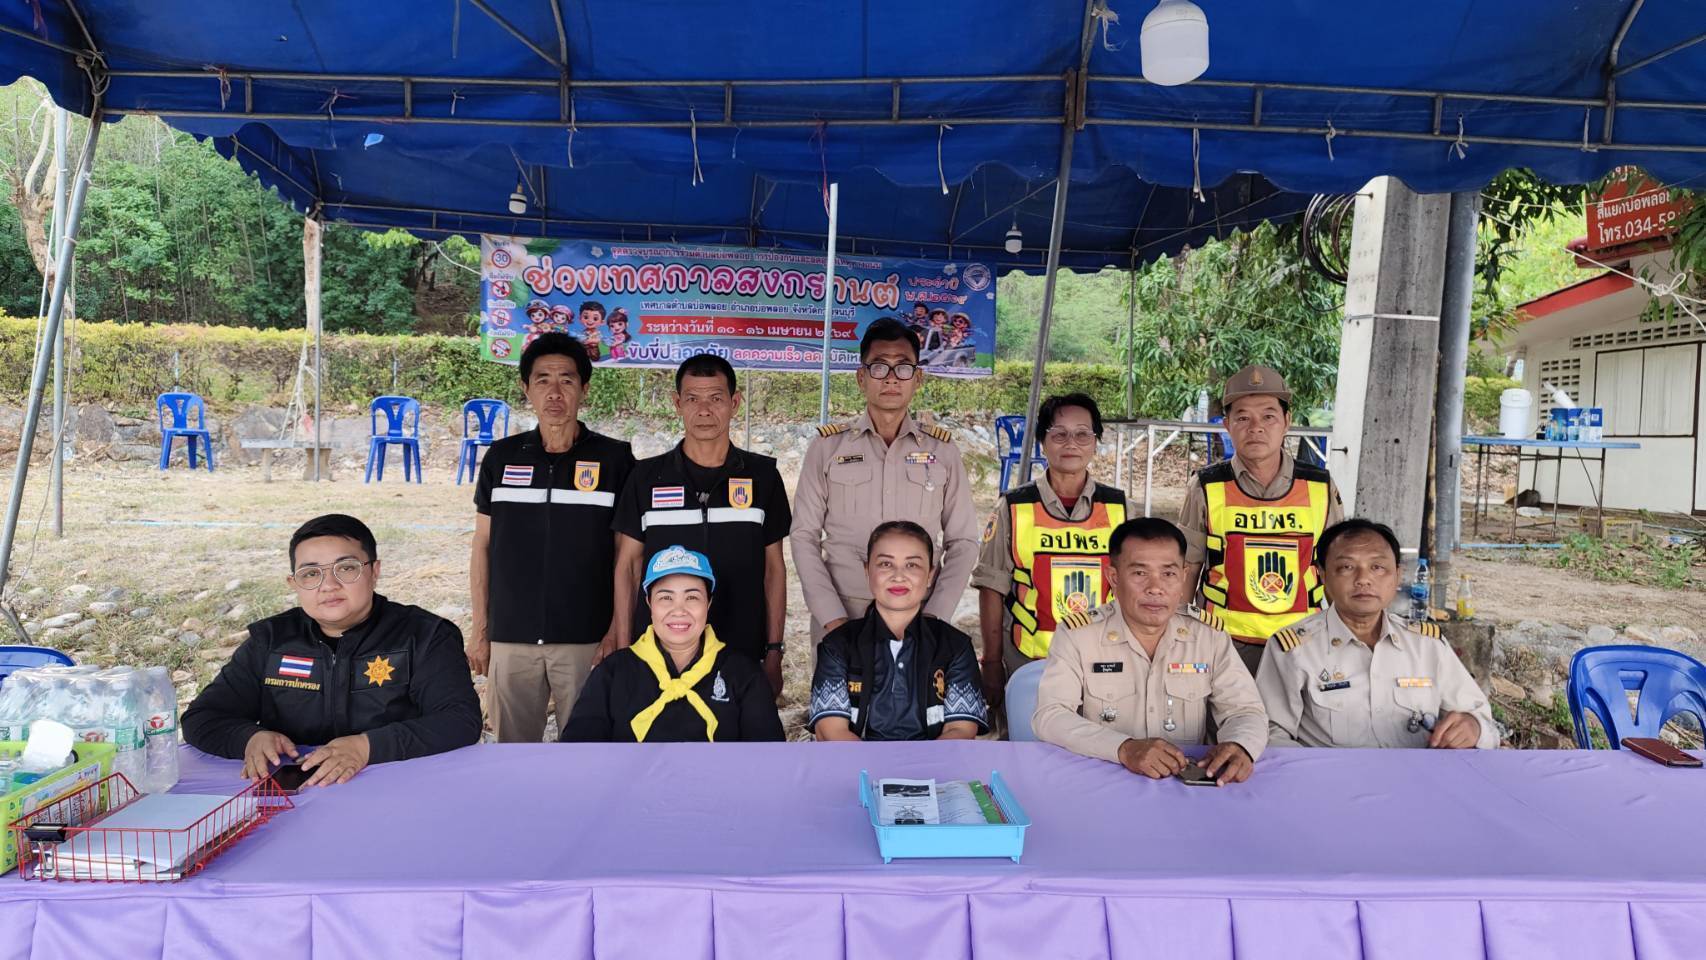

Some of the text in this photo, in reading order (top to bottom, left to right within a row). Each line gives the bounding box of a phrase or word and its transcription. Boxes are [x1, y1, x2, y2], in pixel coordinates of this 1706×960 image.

[646, 317, 714, 333] ระหว่างวันที่
[717, 326, 735, 334] ๑๐
[746, 325, 764, 335] ๑๖
[767, 327, 812, 337] เมษายน
[815, 328, 852, 338] ๒๖๙
[733, 346, 800, 361] ลดความเร็ว
[1235, 511, 1303, 529] อปพร.
[1040, 531, 1107, 549] อปพร.
[264, 677, 321, 691] กรมการปกครอง
